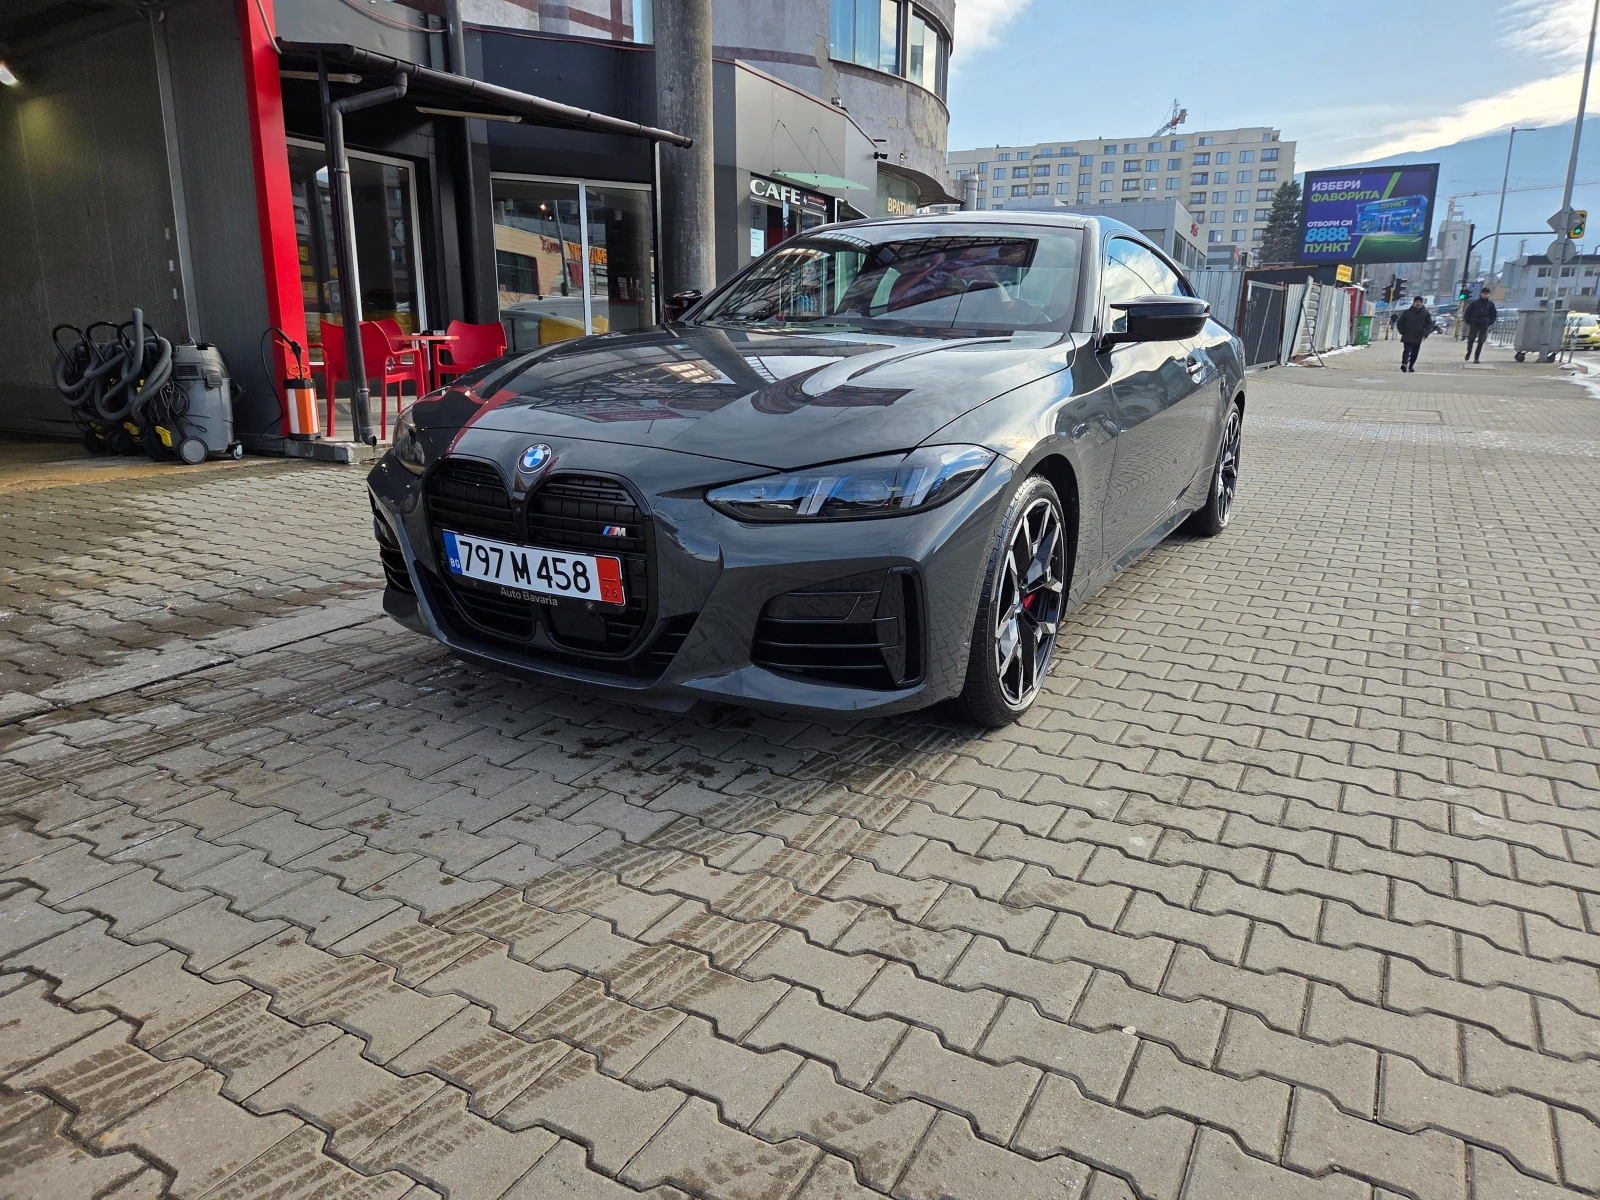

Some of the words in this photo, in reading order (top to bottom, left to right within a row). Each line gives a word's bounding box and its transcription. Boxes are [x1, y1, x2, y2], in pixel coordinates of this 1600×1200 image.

[1312, 180, 1361, 191] ИЗБЕРИ
[750, 179, 801, 205] CAFE
[1311, 191, 1380, 203] ФАВОРИТА
[1307, 220, 1340, 228] ОТВОРИ
[1341, 219, 1353, 227] СИ
[1304, 242, 1351, 254] ПУНКТ
[450, 557, 461, 569] BG
[459, 540, 504, 579] 797
[509, 550, 531, 585] M
[536, 555, 591, 594] 458
[500, 586, 522, 600] Auto
[523, 592, 558, 607] Bavaria
[604, 586, 618, 598] 26
